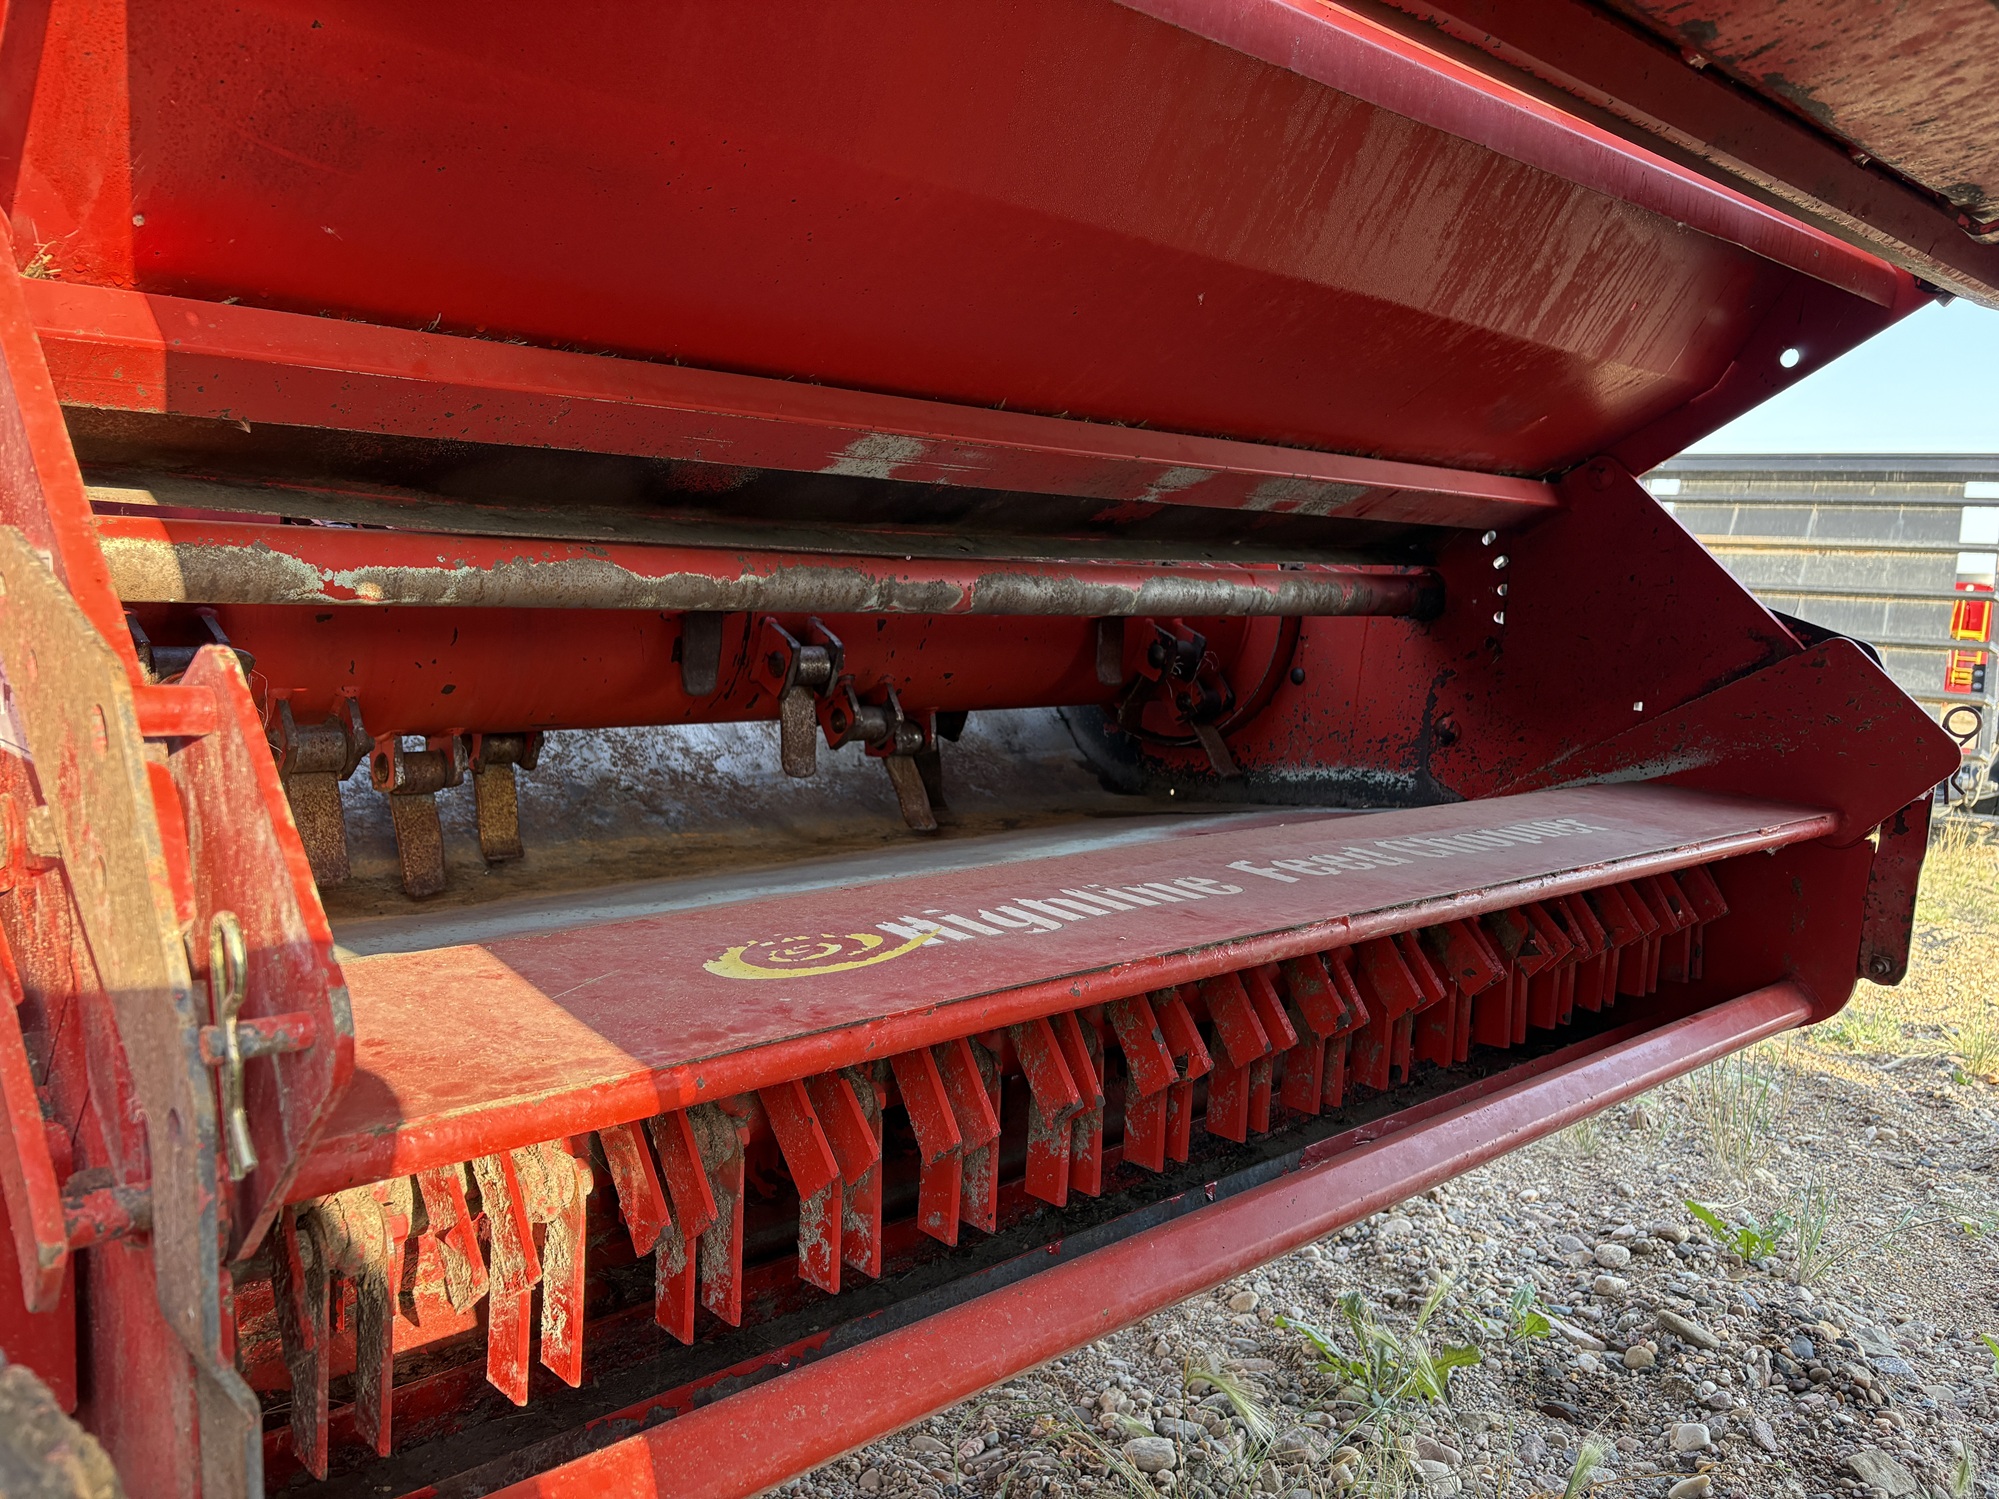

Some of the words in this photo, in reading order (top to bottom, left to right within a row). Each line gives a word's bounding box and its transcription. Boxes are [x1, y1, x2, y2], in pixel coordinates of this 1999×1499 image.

[875, 876, 1244, 946] Highline
[1225, 847, 1414, 883] Feed
[1373, 818, 1610, 858] Chopper
